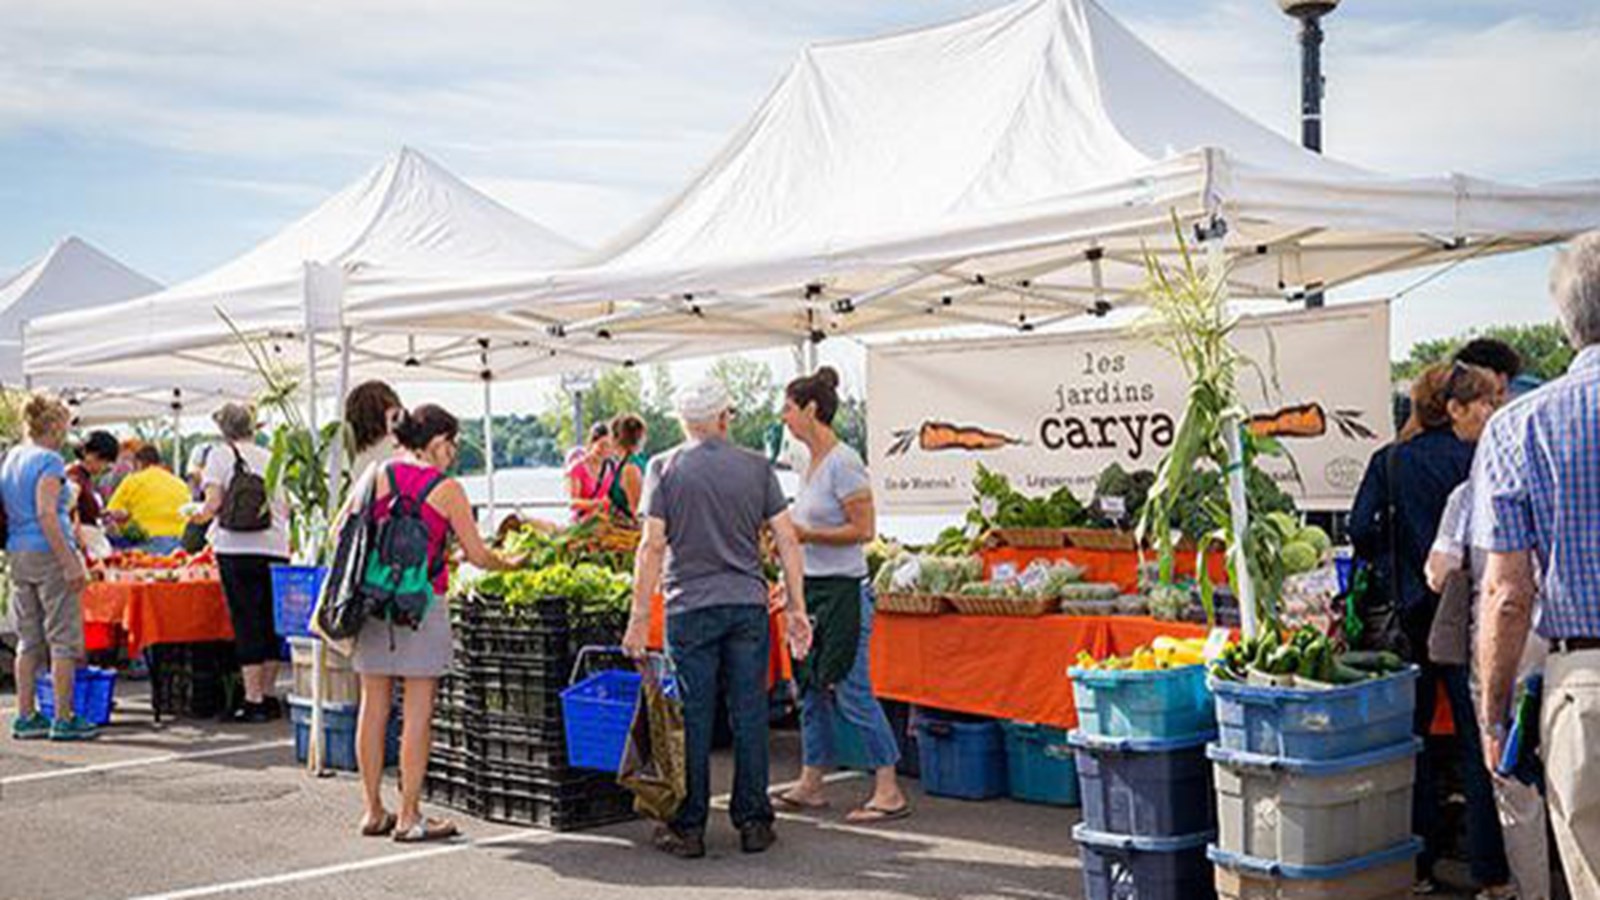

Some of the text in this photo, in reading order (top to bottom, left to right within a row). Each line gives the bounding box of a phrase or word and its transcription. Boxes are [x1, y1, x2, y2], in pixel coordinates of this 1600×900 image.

[1083, 351, 1126, 375] les
[1055, 380, 1155, 413] jardins
[1040, 412, 1176, 460] carya
